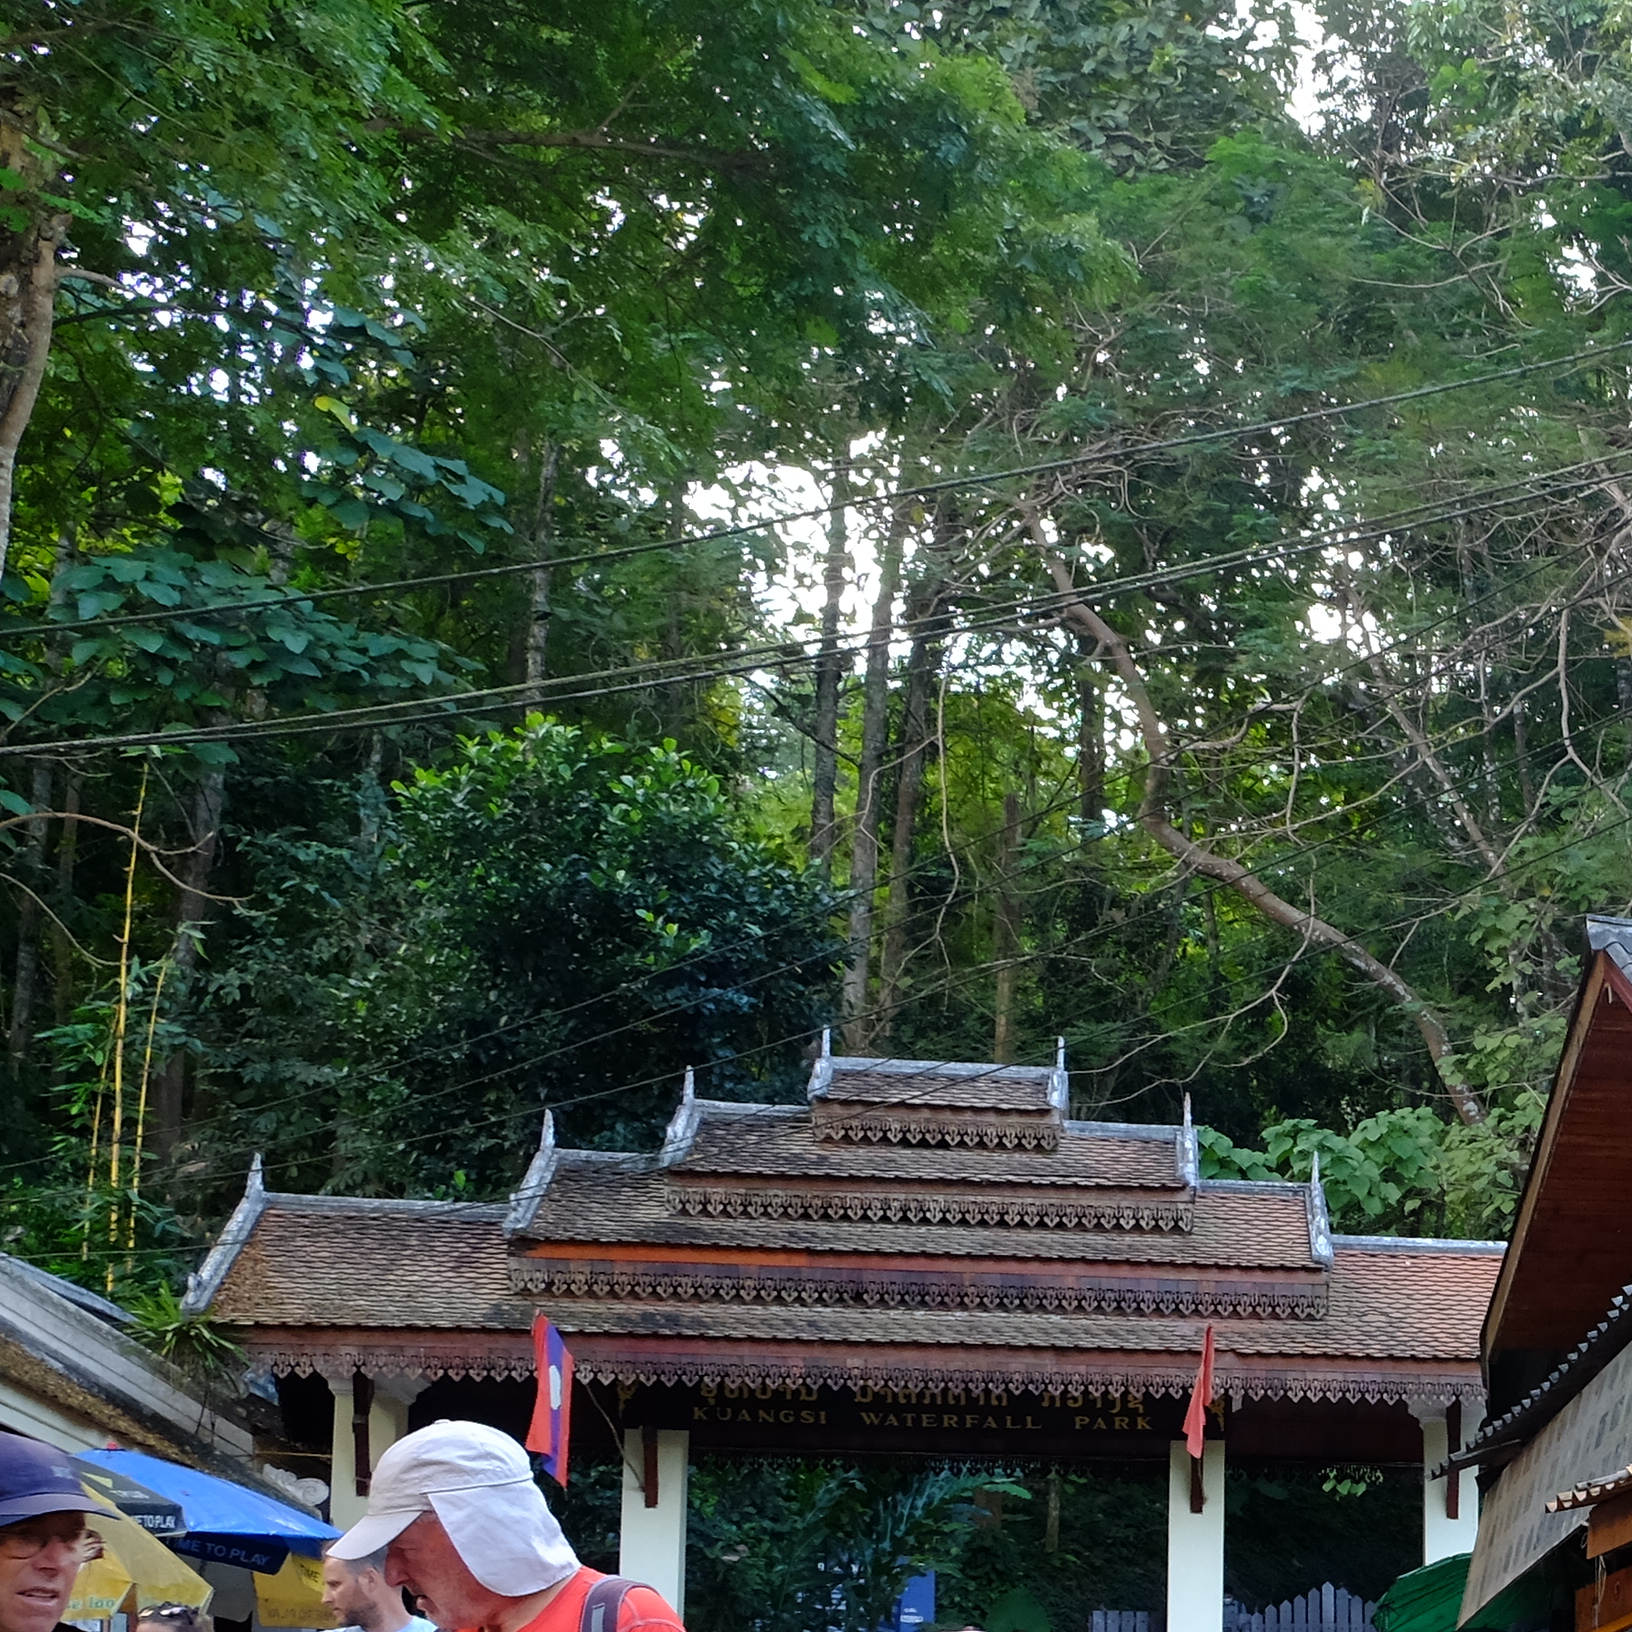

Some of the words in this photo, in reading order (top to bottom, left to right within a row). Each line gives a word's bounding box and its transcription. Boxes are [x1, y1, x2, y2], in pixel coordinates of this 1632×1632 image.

[691, 1405, 828, 1425] KUANGSI
[859, 1411, 1042, 1430] WATERFALL
[1074, 1415, 1153, 1431] PARK
[206, 1543, 226, 1557] TO
[229, 1548, 270, 1566] PLAY
